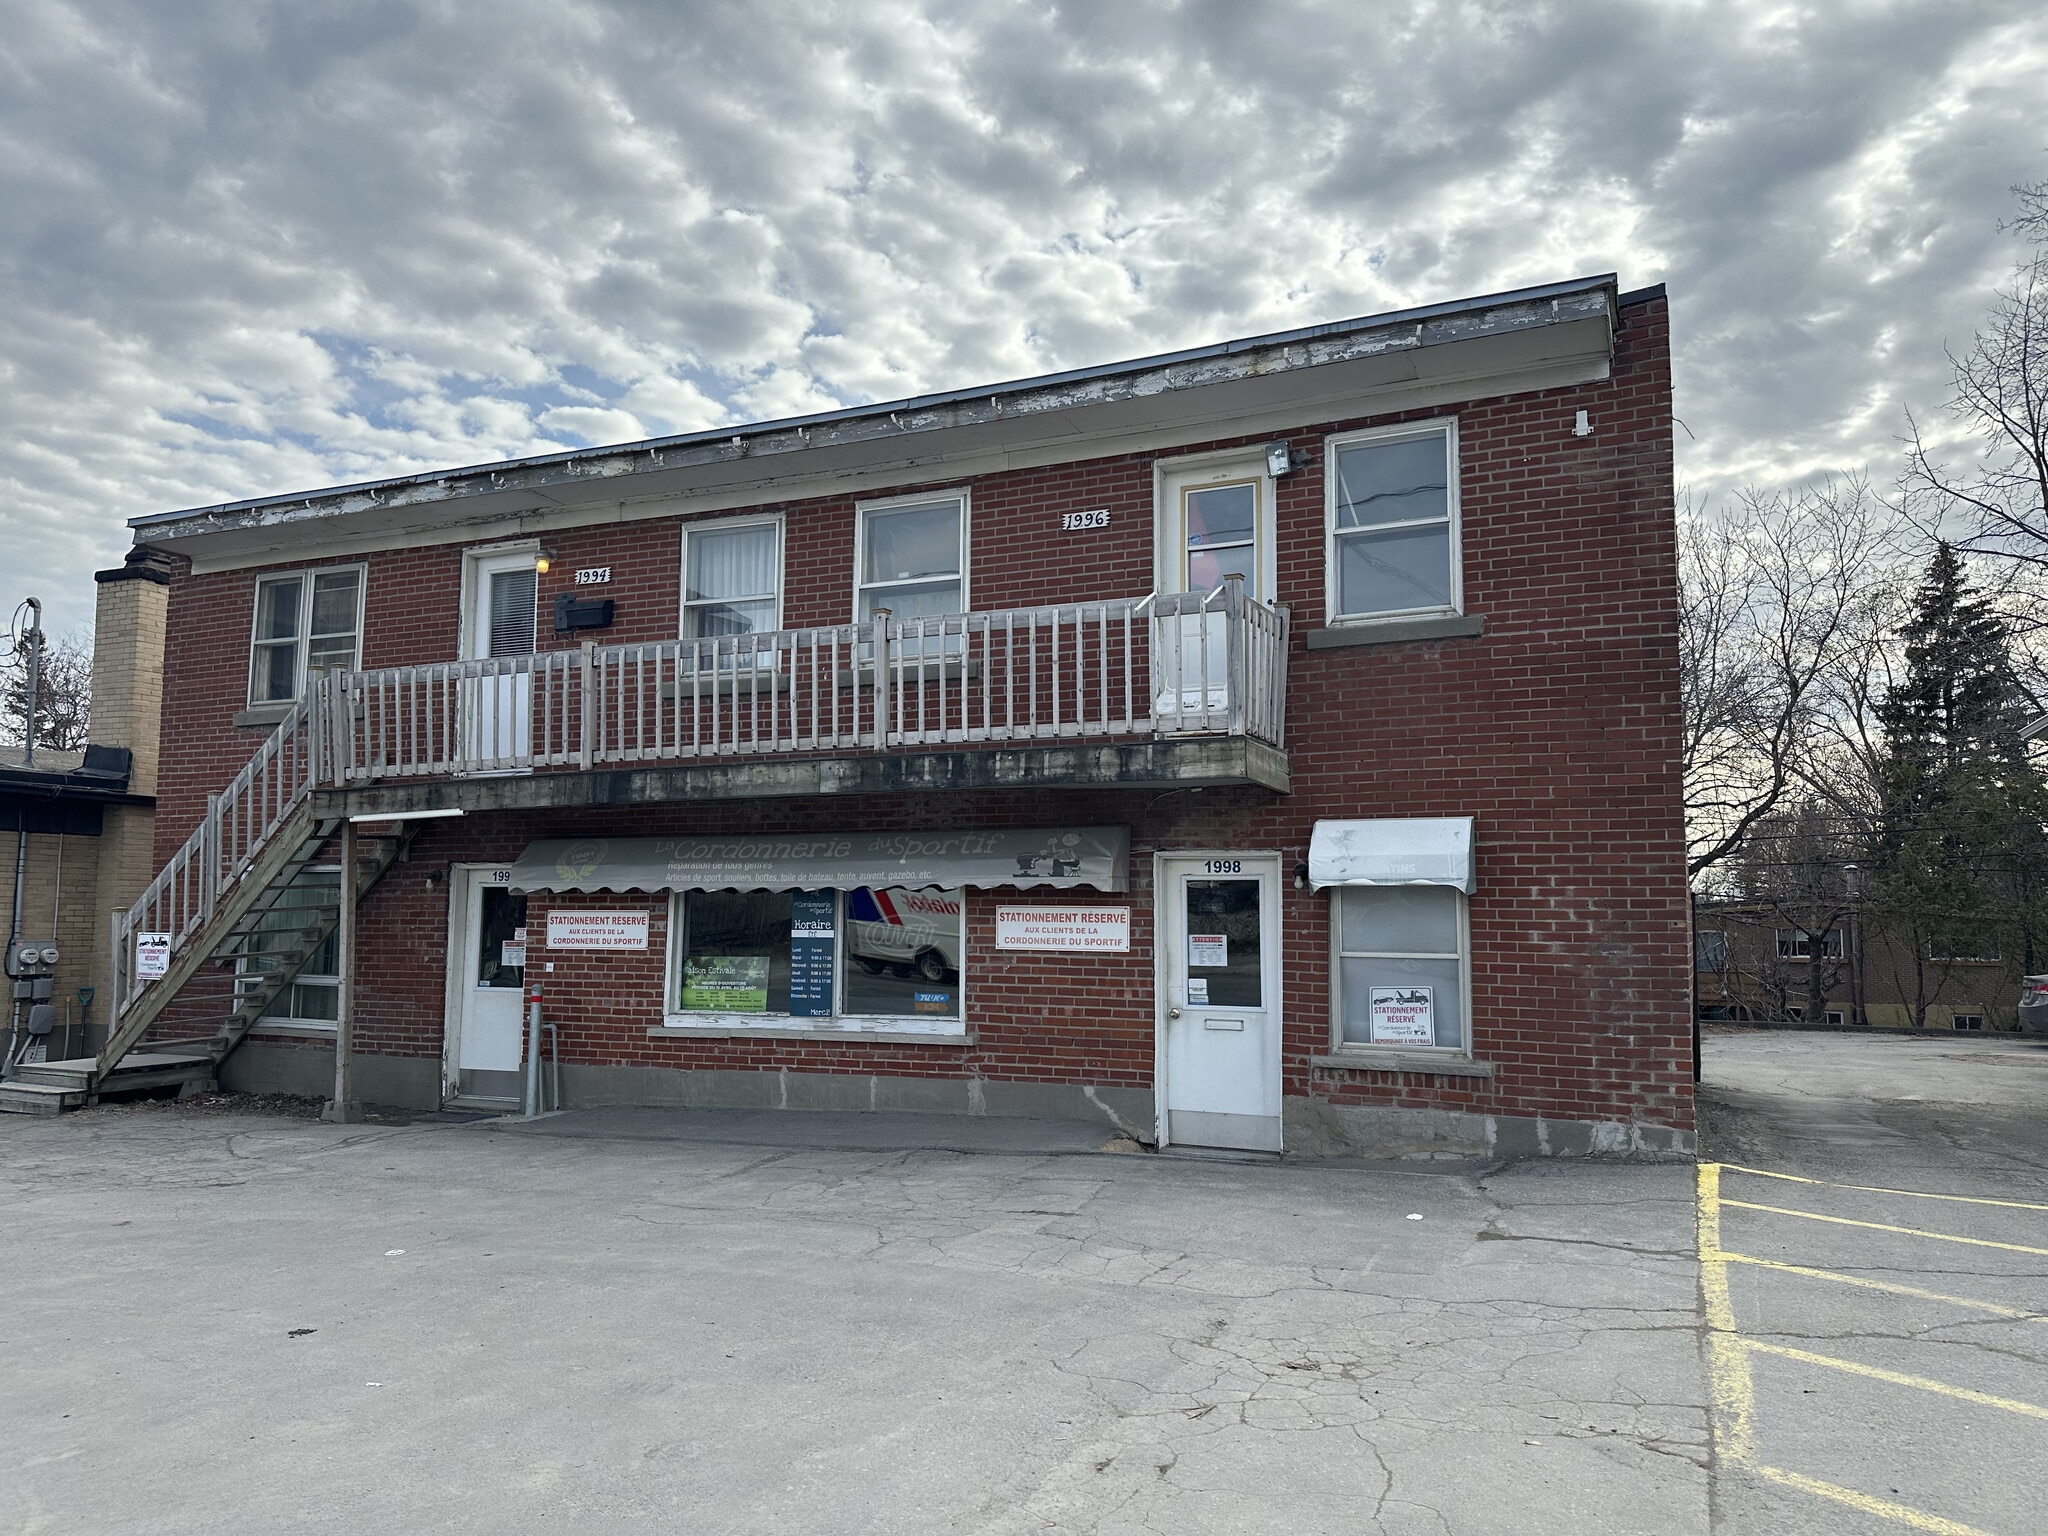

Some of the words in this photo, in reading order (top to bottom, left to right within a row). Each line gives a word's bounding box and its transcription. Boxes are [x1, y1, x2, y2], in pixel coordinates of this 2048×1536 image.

[1066, 511, 1104, 529] 1996
[578, 569, 607, 583] 1994
[674, 836, 851, 860] Cordonnerie
[868, 837, 891, 851] du
[888, 831, 1005, 864] Sportif
[1204, 860, 1241, 873] 1998
[492, 871, 510, 881] 199
[665, 873, 692, 882] Articles
[692, 873, 701, 881] de
[703, 873, 722, 883] sport,
[724, 872, 752, 882] souliers,
[755, 872, 779, 882] bottes,
[780, 872, 796, 881] toile
[798, 872, 806, 881] de
[808, 872, 834, 882] bateau,
[837, 871, 857, 881] tente,
[888, 870, 917, 881] gazebo,
[919, 870, 933, 879] etc.
[549, 916, 610, 925] STATIONNEMENT
[612, 914, 646, 925] RÉSERVÉ
[999, 912, 1078, 922] STATIONNEMENT
[1081, 911, 1126, 923] RÉSERVÉ
[795, 919, 831, 929] Horaire
[872, 923, 939, 945] OUVERT
[1004, 937, 1066, 945] CORDONNERIE
[1084, 938, 1123, 946] SPORTIF
[684, 966, 706, 974] Saison
[708, 966, 736, 974] Estivale
[1374, 1006, 1428, 1014] STATIONNEMENT
[1387, 1015, 1416, 1023] RÉSERVÉ
